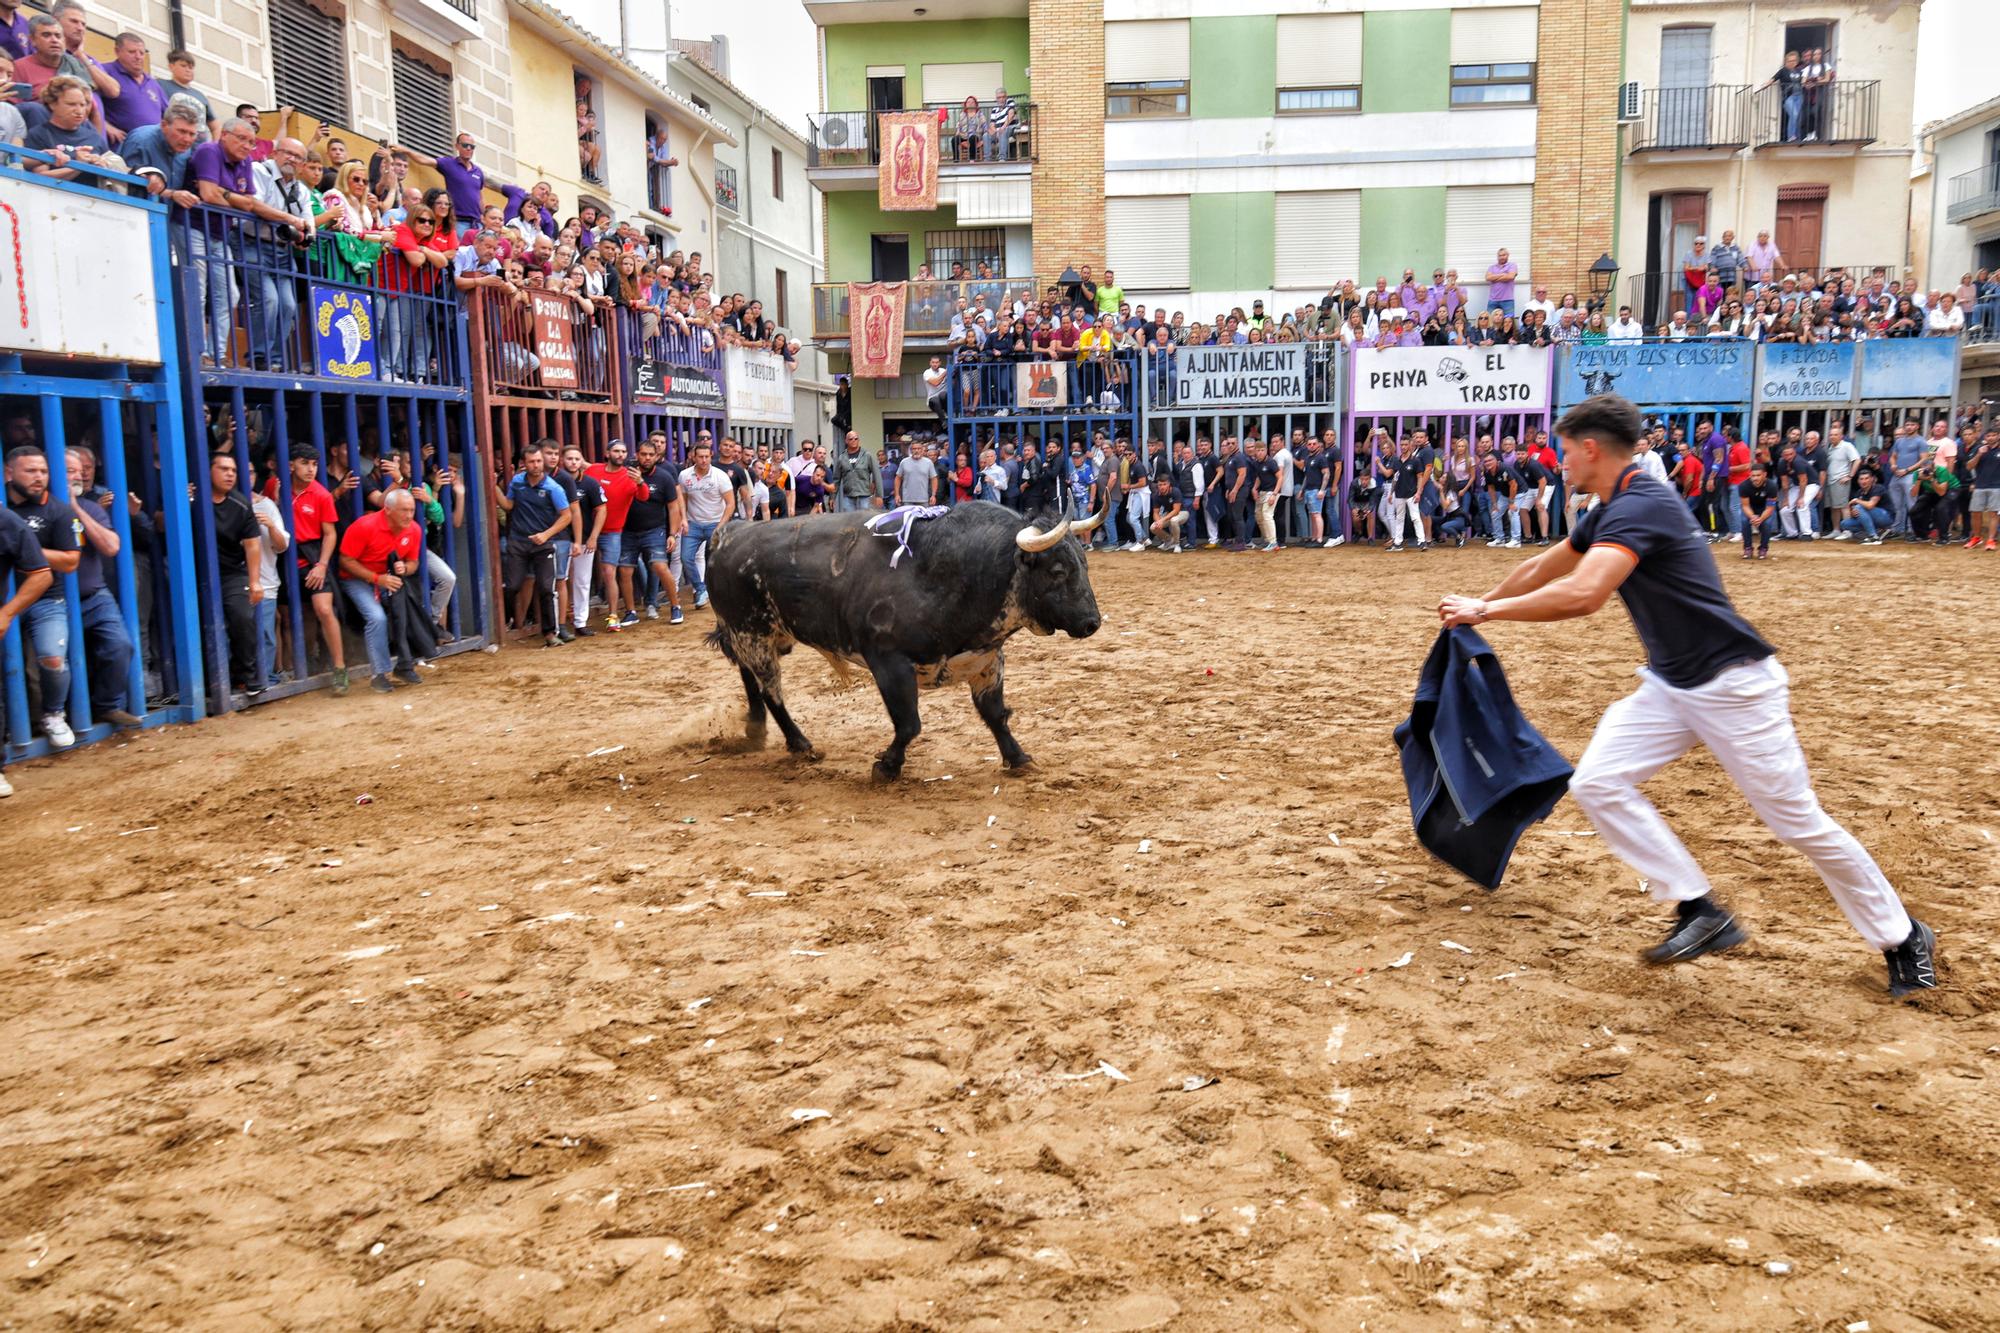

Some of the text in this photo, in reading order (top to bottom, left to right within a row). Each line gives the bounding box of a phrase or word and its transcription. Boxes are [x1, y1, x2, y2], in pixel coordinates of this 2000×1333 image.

[547, 321, 562, 339] LA
[539, 341, 573, 361] COLLA
[1576, 350, 1628, 367] PENYA
[1637, 349, 1667, 366] ELS
[1187, 350, 1296, 374] AJUNTAMENT
[1486, 353, 1506, 371] EL
[1203, 376, 1302, 399] ALMASSORA
[1370, 369, 1428, 390] PENYA
[1459, 384, 1531, 403] TRASTO
